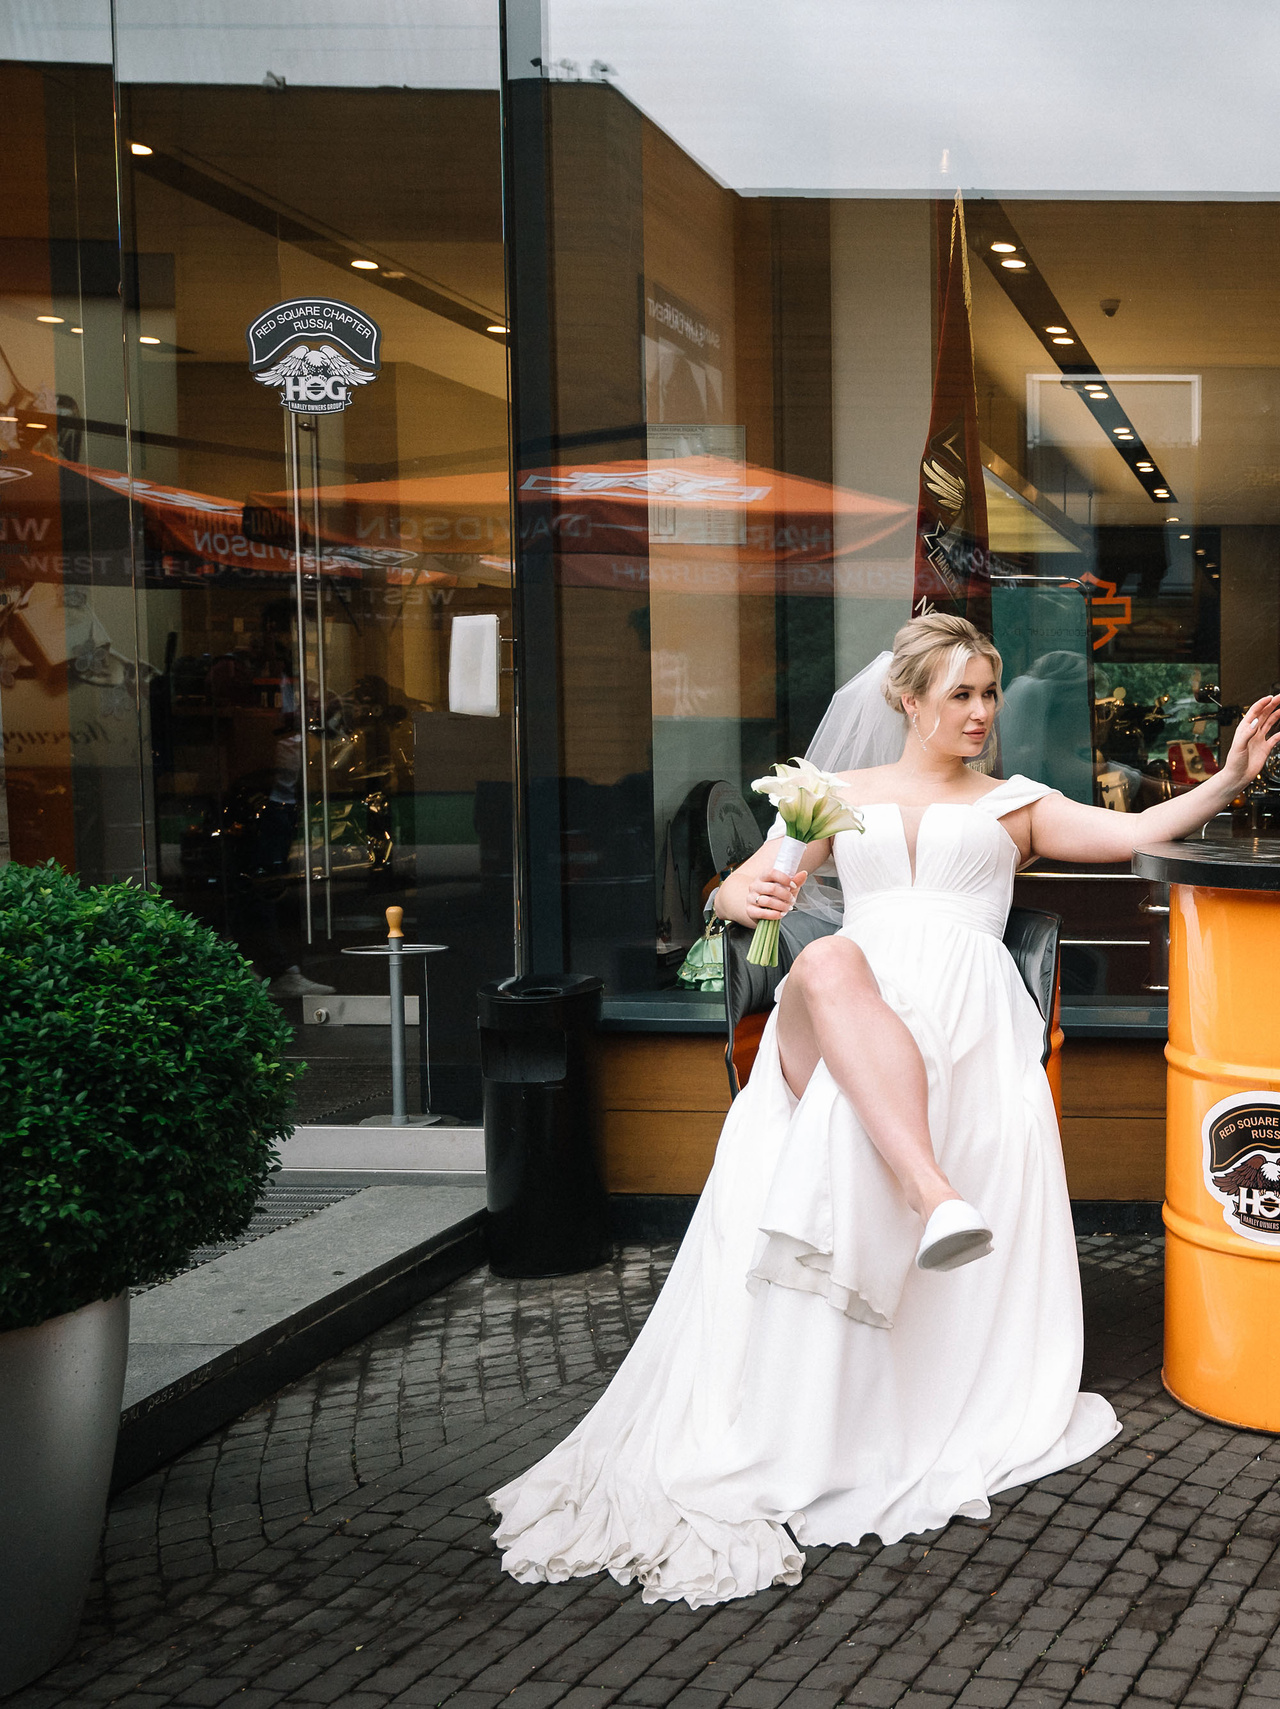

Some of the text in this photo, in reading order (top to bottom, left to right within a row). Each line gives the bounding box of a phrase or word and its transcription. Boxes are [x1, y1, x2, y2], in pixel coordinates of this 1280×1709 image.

[255, 306, 372, 340] RED SQUARE CHAPTER
[294, 318, 334, 332] RUSSIA
[291, 402, 307, 411] HARLEY
[327, 402, 343, 411] GROUP
[1218, 1122, 1237, 1140] RED
[1236, 1116, 1280, 1130] SQUARE
[1242, 1215, 1260, 1227] HARLEY
[1259, 1220, 1280, 1230] OWNERS
